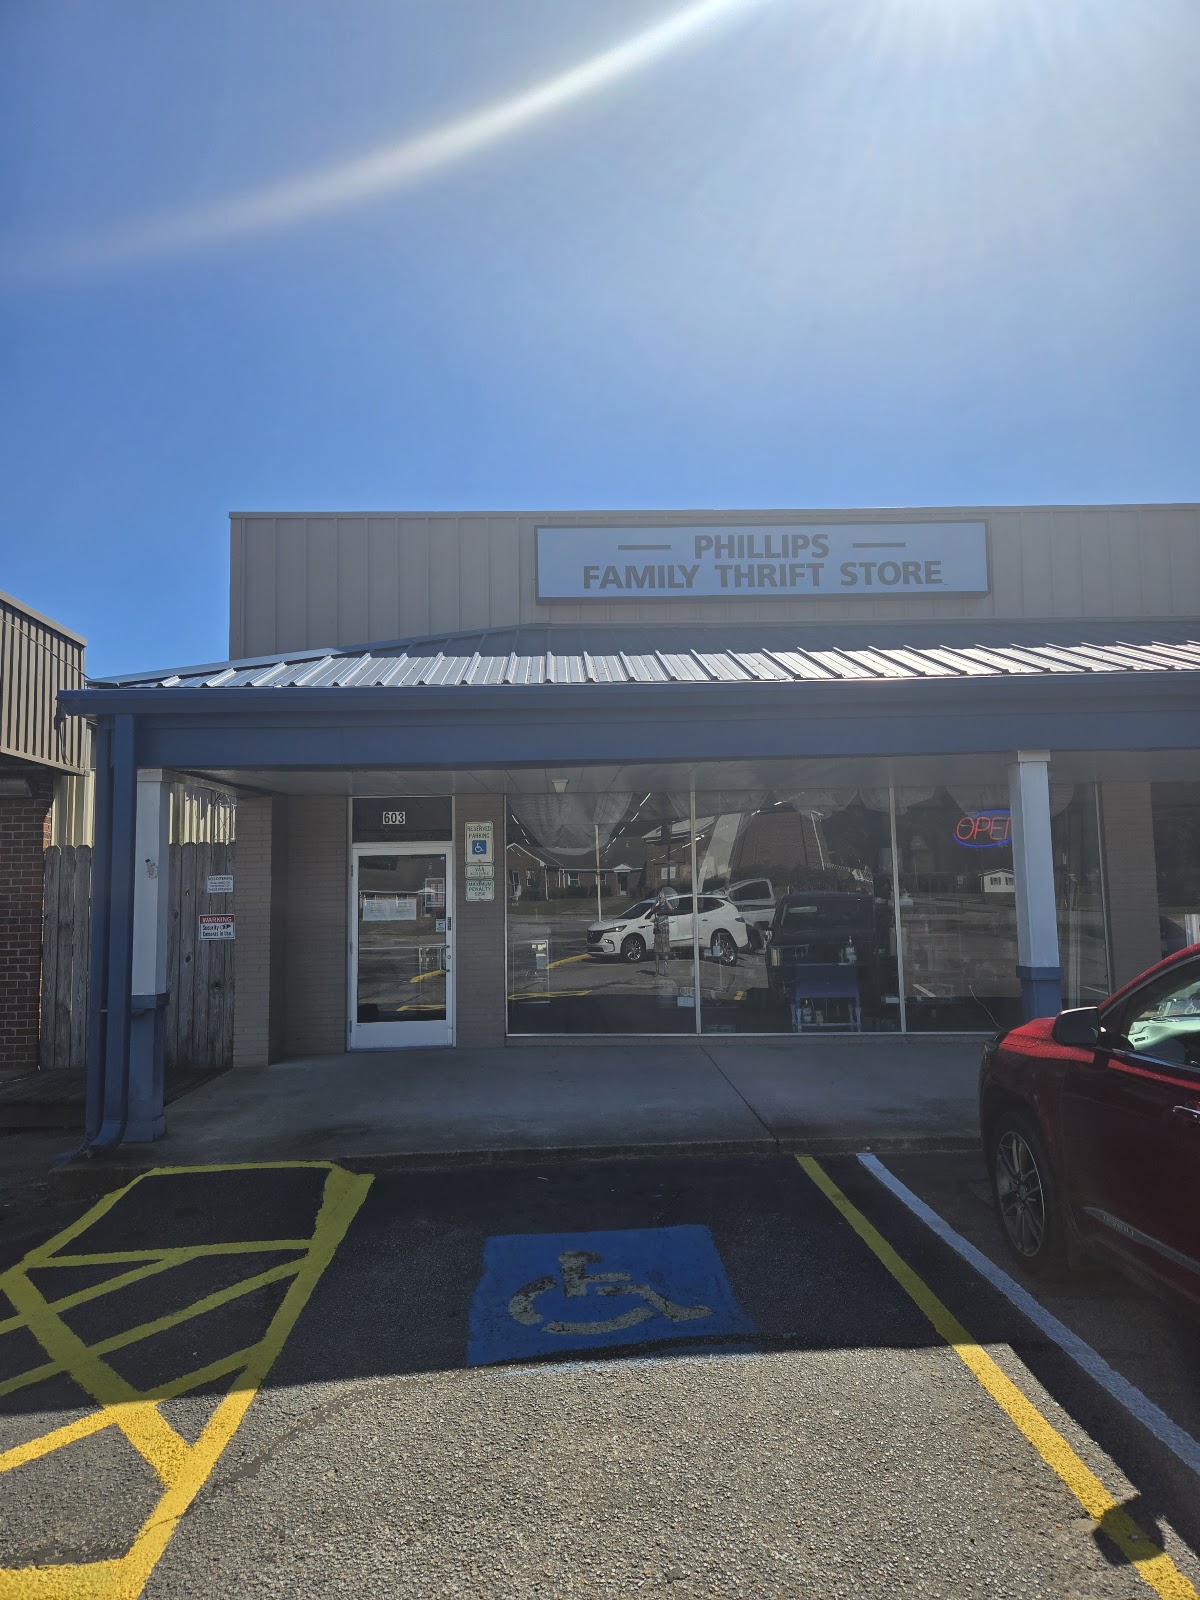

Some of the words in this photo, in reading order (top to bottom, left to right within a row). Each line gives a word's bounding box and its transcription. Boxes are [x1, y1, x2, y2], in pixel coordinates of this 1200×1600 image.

[694, 534, 830, 560] PHILLIPS
[582, 563, 700, 590] FAMILY
[714, 562, 825, 588] THRIFT
[839, 561, 943, 587] STORE
[383, 812, 405, 824] 603
